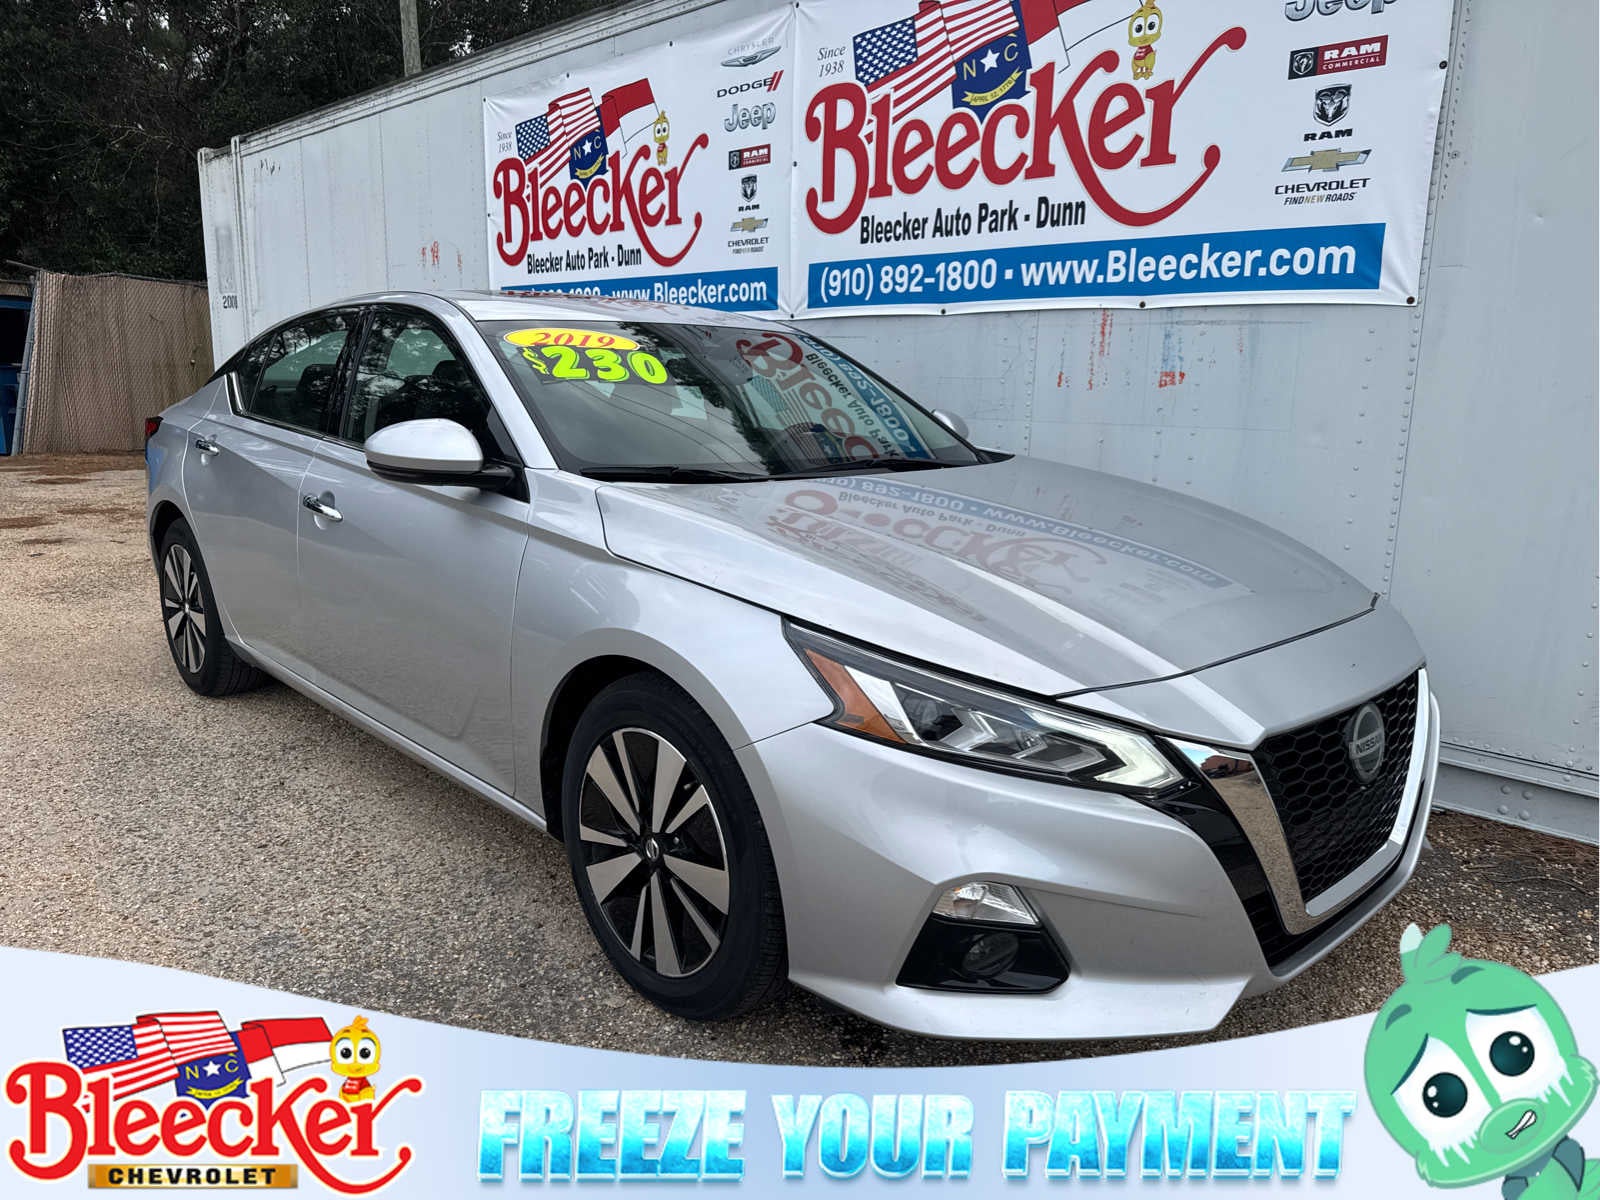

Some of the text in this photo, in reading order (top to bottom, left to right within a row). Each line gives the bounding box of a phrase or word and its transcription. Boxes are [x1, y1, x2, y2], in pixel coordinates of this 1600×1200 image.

[1285, 0, 1398, 21] Je
[817, 46, 846, 61] Since
[1324, 42, 1381, 60] RAM
[819, 60, 845, 77] 1938
[963, 43, 1019, 81] N C
[1322, 56, 1380, 70] COMMERCIAL
[716, 77, 774, 98] DODGE
[724, 102, 776, 132] Jeep
[805, 26, 1247, 234] Bleecker
[1304, 128, 1353, 142] RAM
[573, 136, 602, 160] N C
[743, 148, 769, 159] RAM
[1275, 178, 1371, 195] CHEVROLET
[493, 133, 709, 267] Bleecker
[738, 204, 760, 212] RAM
[860, 195, 1086, 244] Bleecker Auto Park Dunn
[728, 237, 769, 248] CHEVROLET
[527, 244, 642, 275] Bleecker Auto Park Dunn
[820, 242, 1356, 303] (910) 892-1800 www.Bleecker.com
[610, 279, 767, 304] wwwBleecker.com
[532, 332, 616, 347] 2019
[523, 346, 668, 384] $230
[1354, 734, 1379, 755] NISSAN
